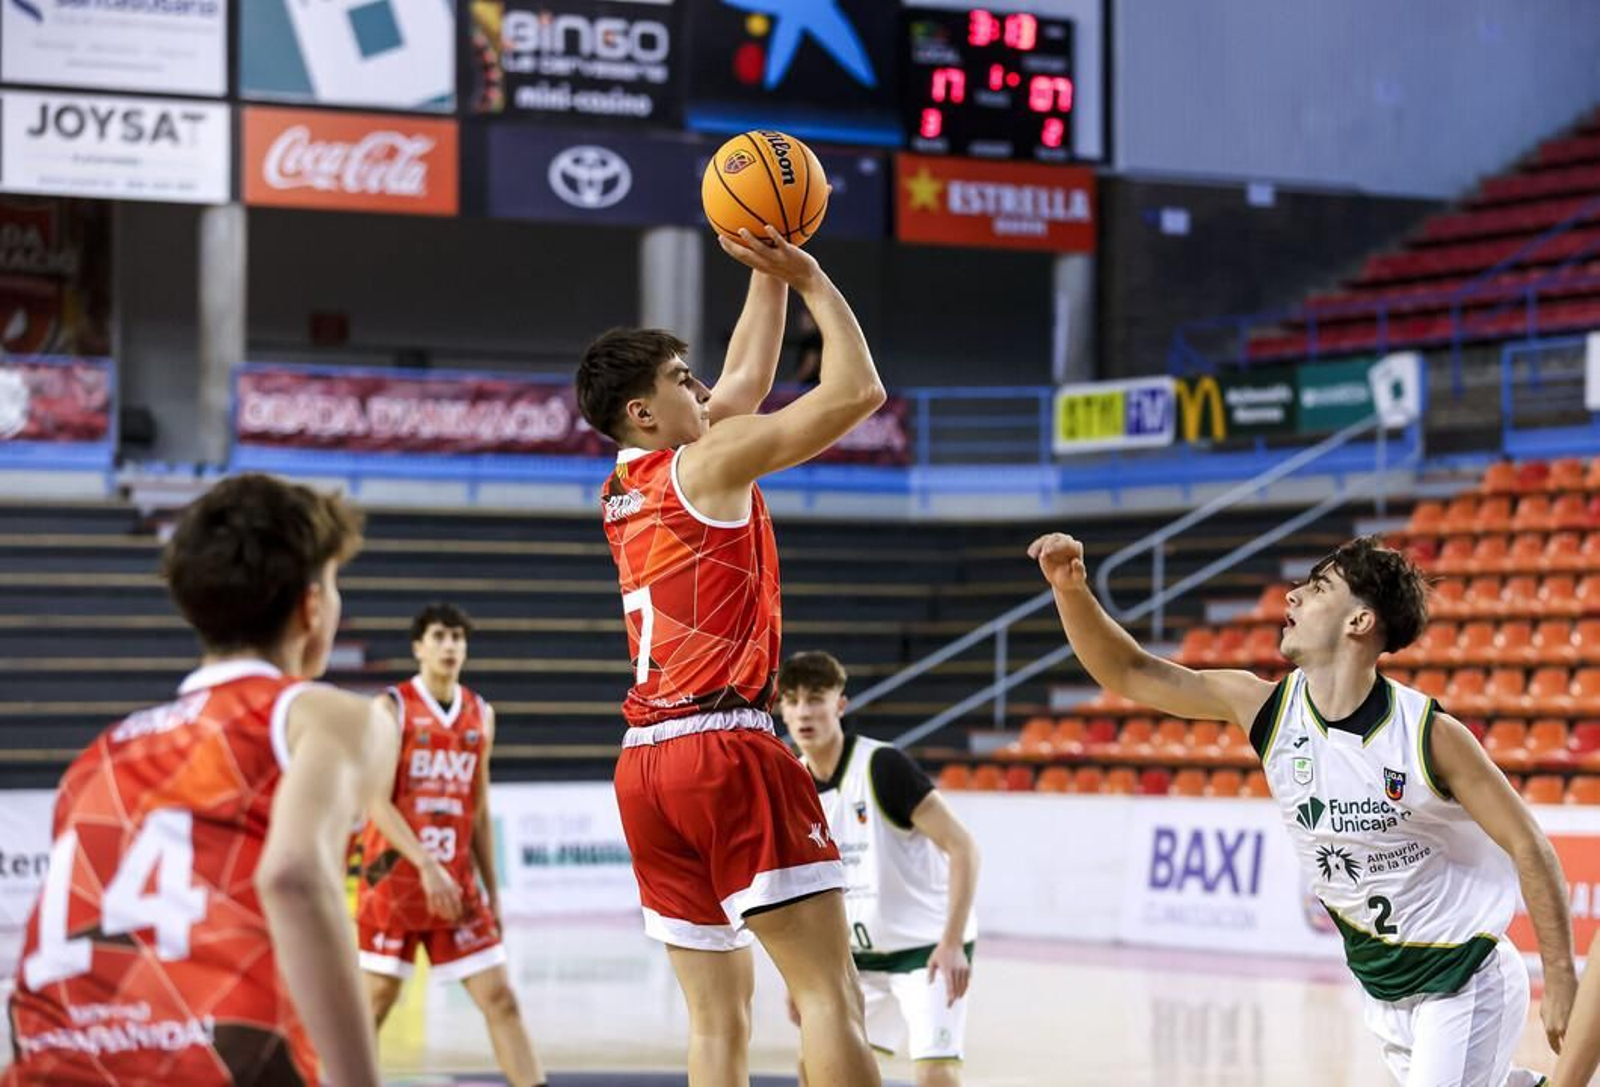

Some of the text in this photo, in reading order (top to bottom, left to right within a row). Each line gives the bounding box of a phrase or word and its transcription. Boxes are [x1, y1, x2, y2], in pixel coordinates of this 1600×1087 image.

[27, 102, 207, 146] JOYSAT
[948, 179, 1091, 221] ESTRELLA
[409, 749, 478, 784] BAXI
[1328, 797, 1412, 822] Fundac
[1330, 815, 1399, 834] Unicaja
[1149, 827, 1264, 897] BAXI
[1369, 846, 1432, 874] de la Torre
[23, 807, 209, 992] 14
[1367, 894, 1399, 935] 2
